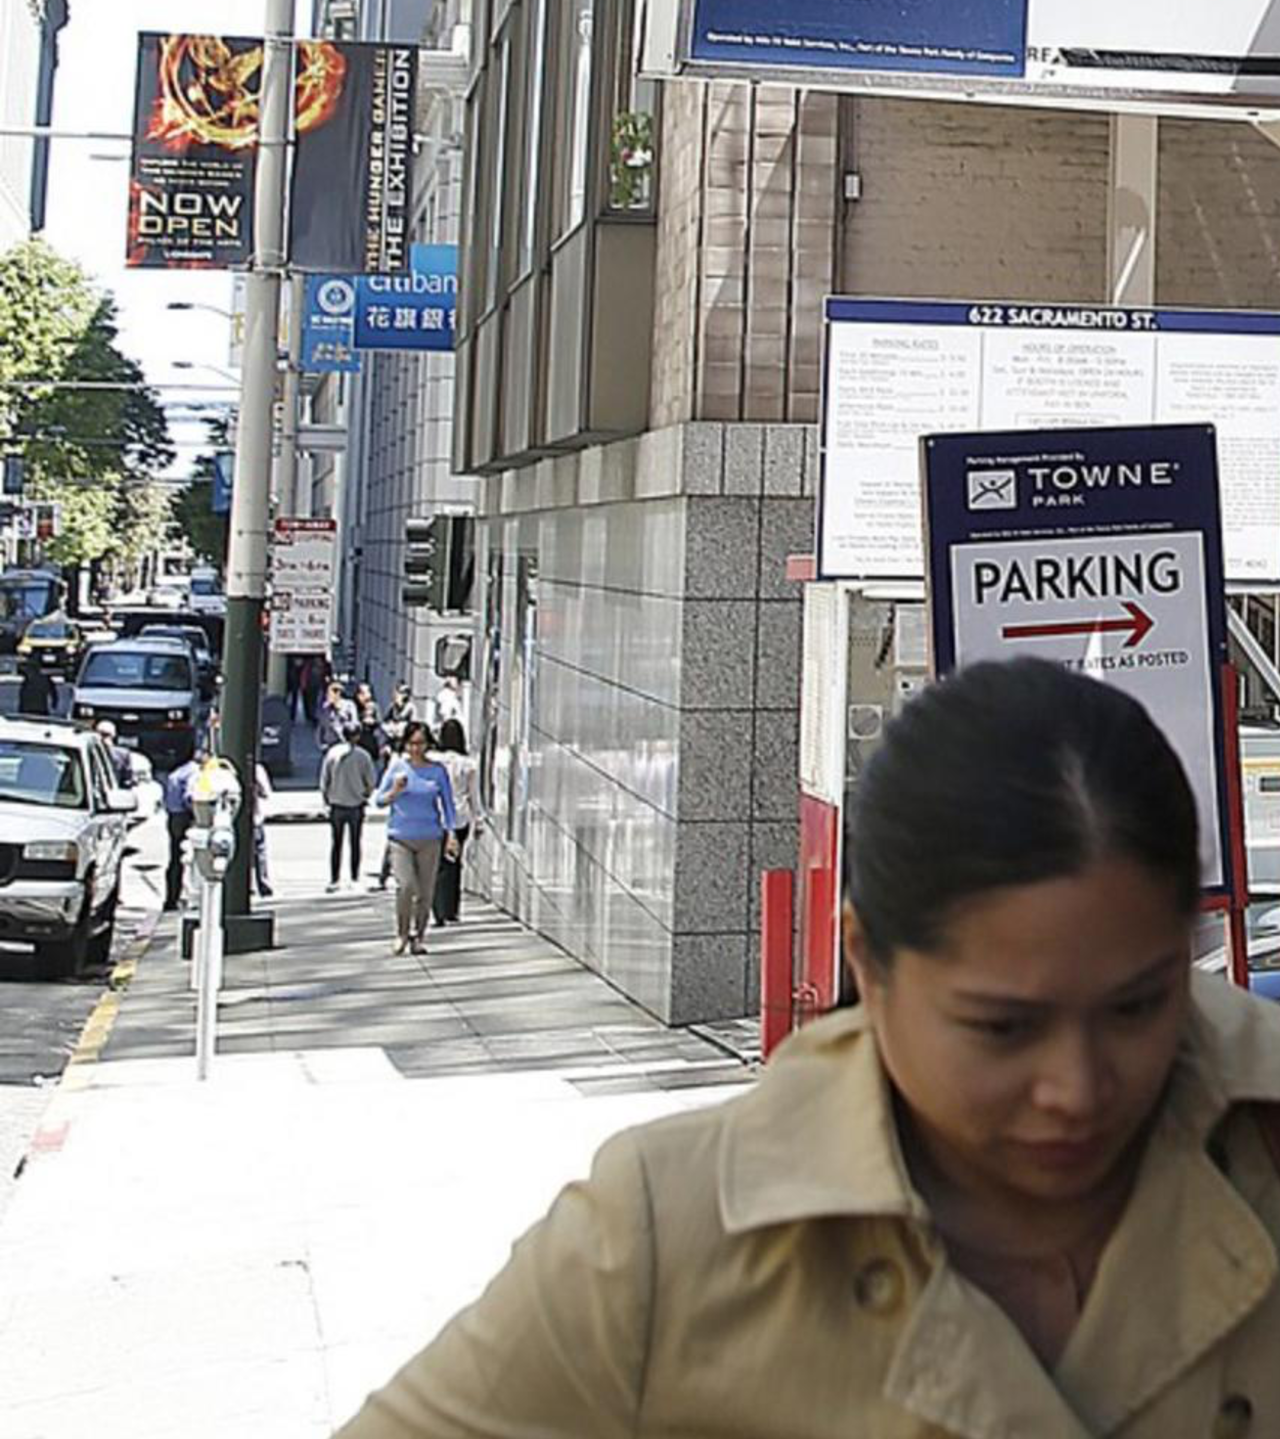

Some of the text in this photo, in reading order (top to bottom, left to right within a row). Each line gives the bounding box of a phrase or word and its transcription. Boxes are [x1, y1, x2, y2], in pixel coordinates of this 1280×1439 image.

[387, 49, 411, 272] THE EXHIBITION
[368, 130, 384, 222] HUNGER
[140, 190, 242, 217] NOW
[138, 215, 239, 237] OPEN
[368, 270, 458, 294] citiban
[969, 308, 1158, 330] 622 SACRAMENTO ST.
[1028, 462, 1173, 490] TOWNE
[1032, 494, 1085, 508] PARK
[973, 551, 1181, 605] PARKING
[1118, 655, 1135, 668] AS
[1137, 651, 1189, 667] POSTED
